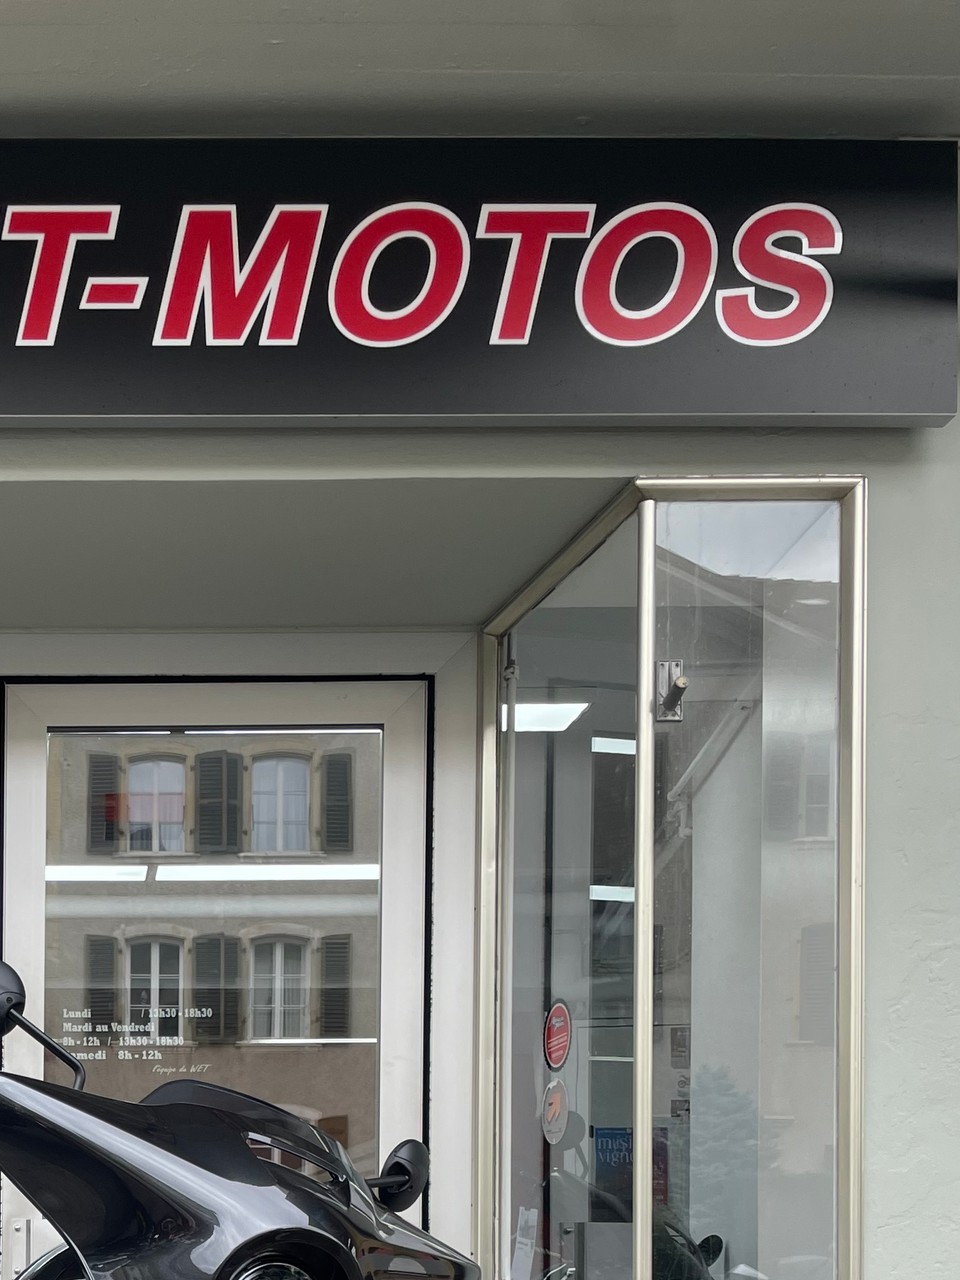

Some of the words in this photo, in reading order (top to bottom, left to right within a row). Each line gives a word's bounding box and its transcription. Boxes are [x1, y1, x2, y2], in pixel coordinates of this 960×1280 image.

[63, 1008, 92, 1018] Lundi
[148, 1008, 177, 1018] 13h30
[184, 1008, 213, 1018] 18h30
[62, 1022, 93, 1032] Mardi
[95, 1024, 109, 1032] au
[110, 1022, 155, 1032] Vendredi
[62, 1036, 75, 1046] 8h
[83, 1036, 100, 1046] 12h
[119, 1036, 148, 1046] 13h30
[155, 1036, 185, 1046] 18h30
[67, 1050, 107, 1060] amedi
[117, 1050, 133, 1060] 8h
[141, 1050, 163, 1060] 12h
[189, 1063, 212, 1073] WET
